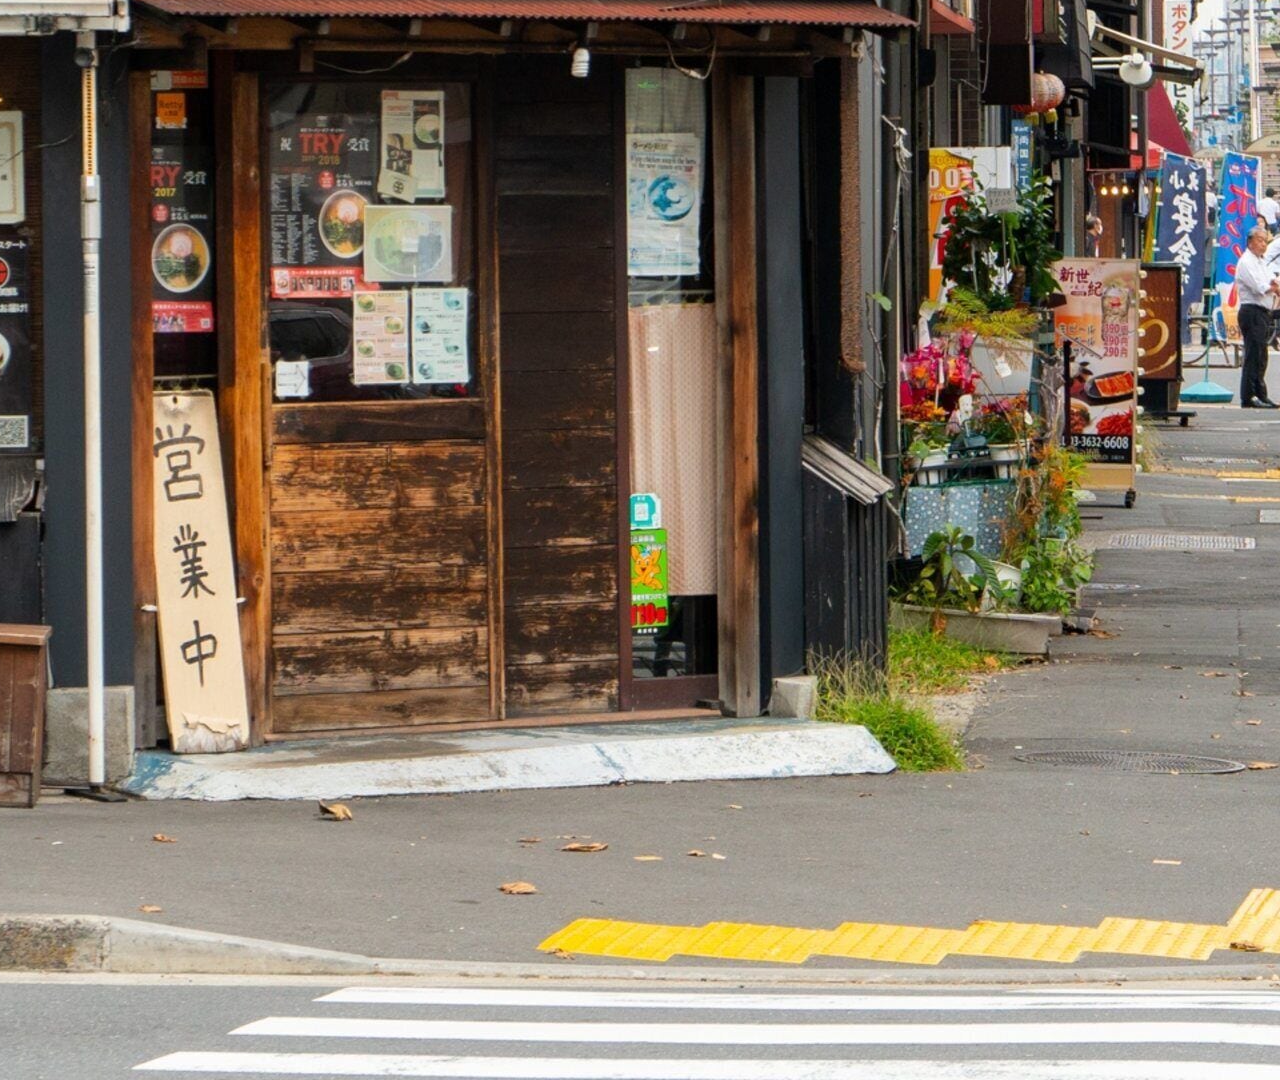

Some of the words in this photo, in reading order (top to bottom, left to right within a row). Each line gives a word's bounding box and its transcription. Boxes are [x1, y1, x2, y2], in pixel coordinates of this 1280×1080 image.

[299, 133, 346, 154] TRY
[1059, 266, 1104, 297] 新世紀
[154, 423, 219, 688] 営業中
